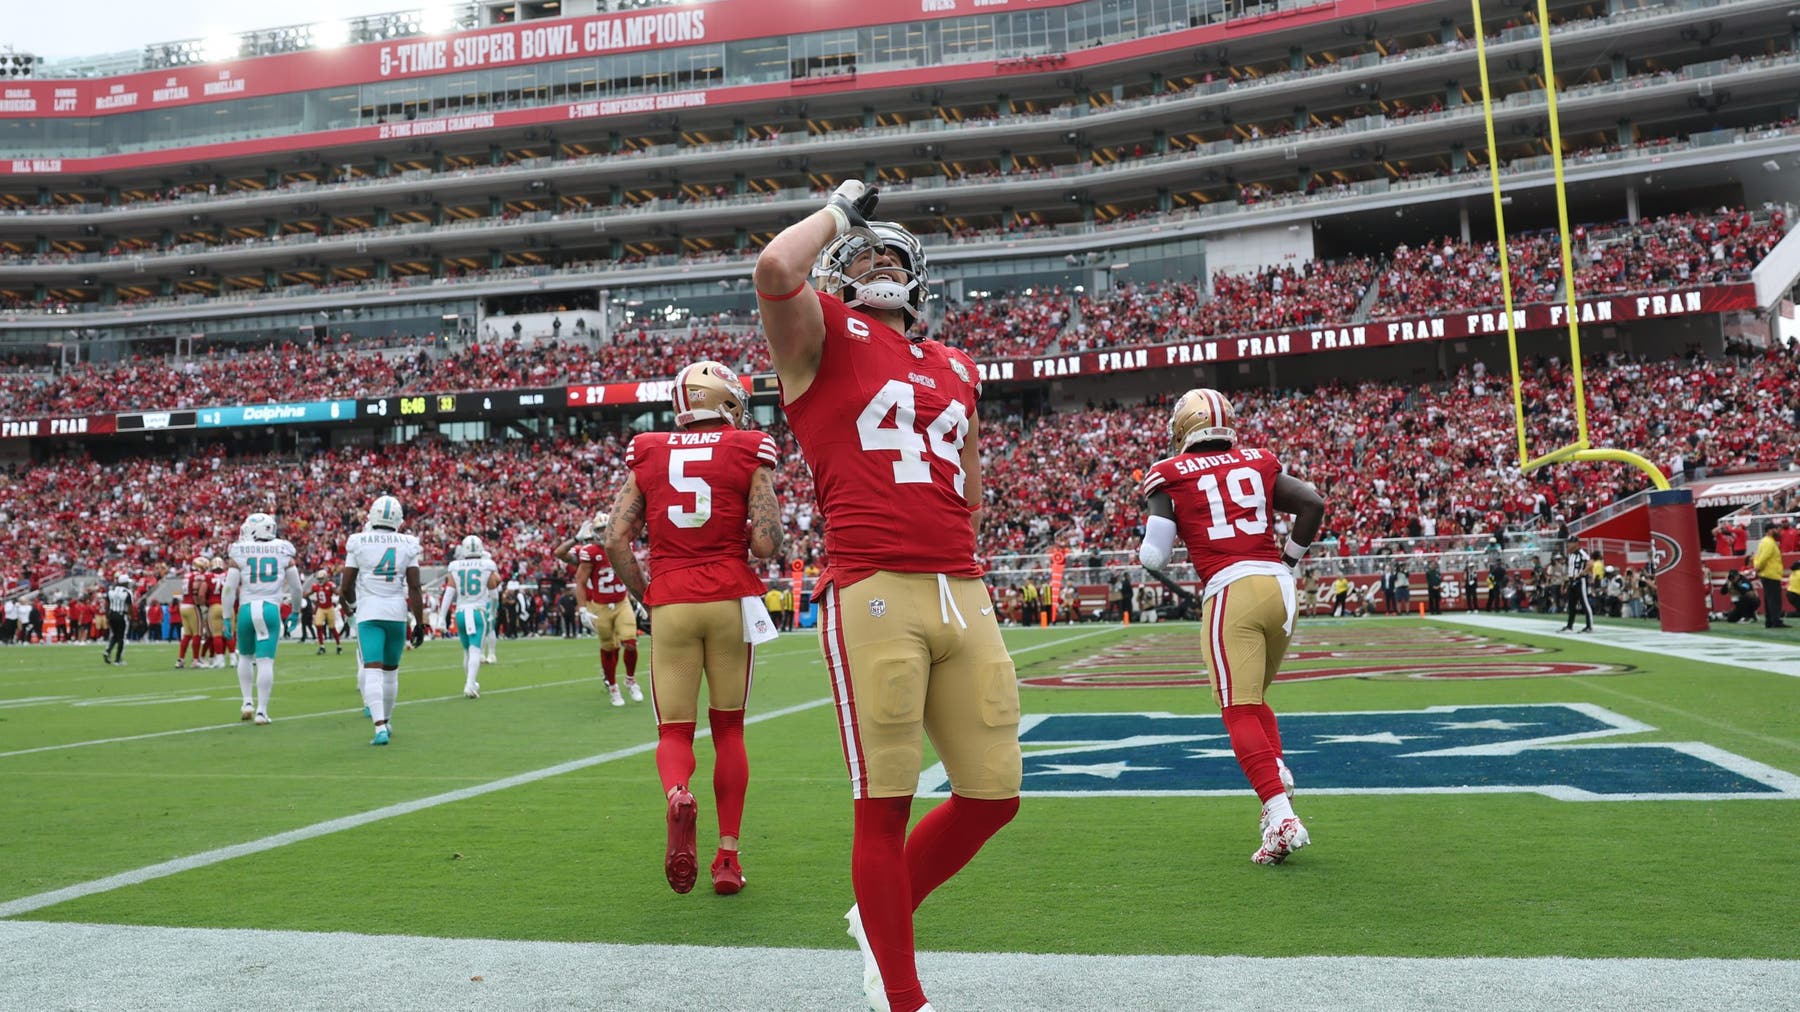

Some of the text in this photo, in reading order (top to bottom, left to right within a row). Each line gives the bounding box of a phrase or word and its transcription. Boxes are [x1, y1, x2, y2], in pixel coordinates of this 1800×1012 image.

[380, 9, 705, 76] 5-TIME SUPER BOWL CHAMPIONS
[54, 98, 77, 111] LOTT
[152, 86, 189, 102] MONTANA
[599, 97, 655, 115] CONFERENCE
[656, 91, 706, 110] CHAMPIONS
[412, 119, 447, 136] DIVISION
[447, 113, 495, 132] CHAMPIONS
[12, 160, 62, 172] BILL WALSH
[846, 317, 869, 337] C
[976, 362, 1014, 380] RAN
[1033, 356, 1081, 378] FRAN
[1099, 349, 1147, 371] FRAN
[1167, 342, 1217, 364] FRAN
[1237, 334, 1290, 357] FRAN
[1311, 326, 1365, 350] FRAN
[1387, 318, 1444, 342] FRAN
[1637, 291, 1701, 317] FRAN
[585, 386, 606, 404] 27
[214, 411, 221, 425] 3
[243, 405, 306, 422] Dolphins
[378, 399, 387, 416] 3
[2, 418, 88, 437] FRAN FRAN
[667, 432, 723, 445] EVANS
[856, 379, 969, 499] 44
[1175, 447, 1263, 476] SAMUEL SR
[667, 447, 713, 528] 5
[1197, 466, 1268, 541] 19
[247, 556, 278, 584] 10
[372, 547, 397, 583] 4
[457, 568, 482, 597] 16
[1440, 581, 1460, 598] 35
